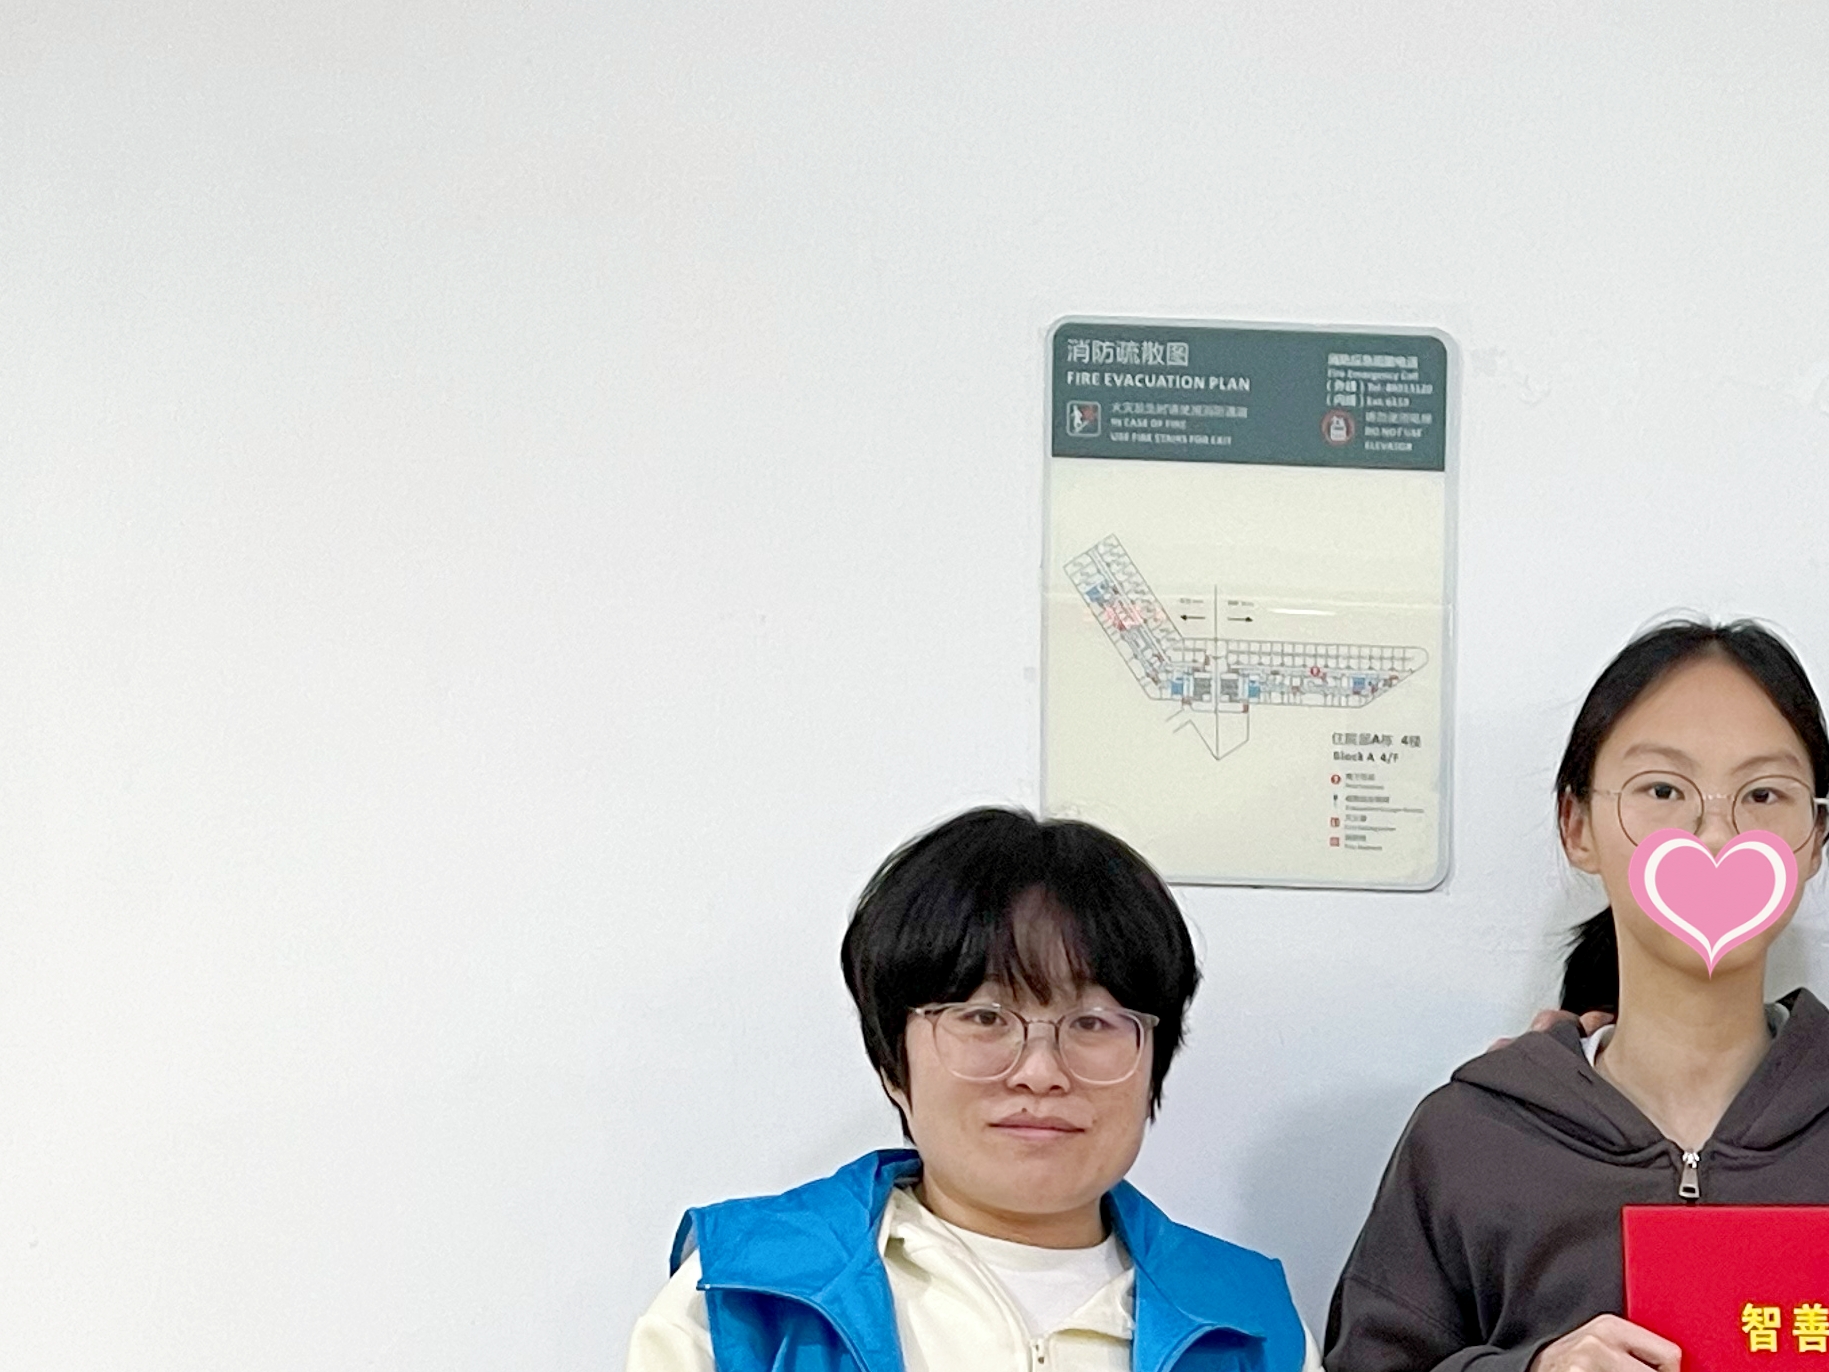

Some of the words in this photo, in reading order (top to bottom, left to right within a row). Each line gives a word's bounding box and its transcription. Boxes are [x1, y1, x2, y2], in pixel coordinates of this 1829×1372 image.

[1067, 338, 1189, 367] 消防疏散图
[1067, 371, 1100, 386] FIRE
[1104, 372, 1205, 390] EVACUATION
[1209, 376, 1251, 391] PLAN
